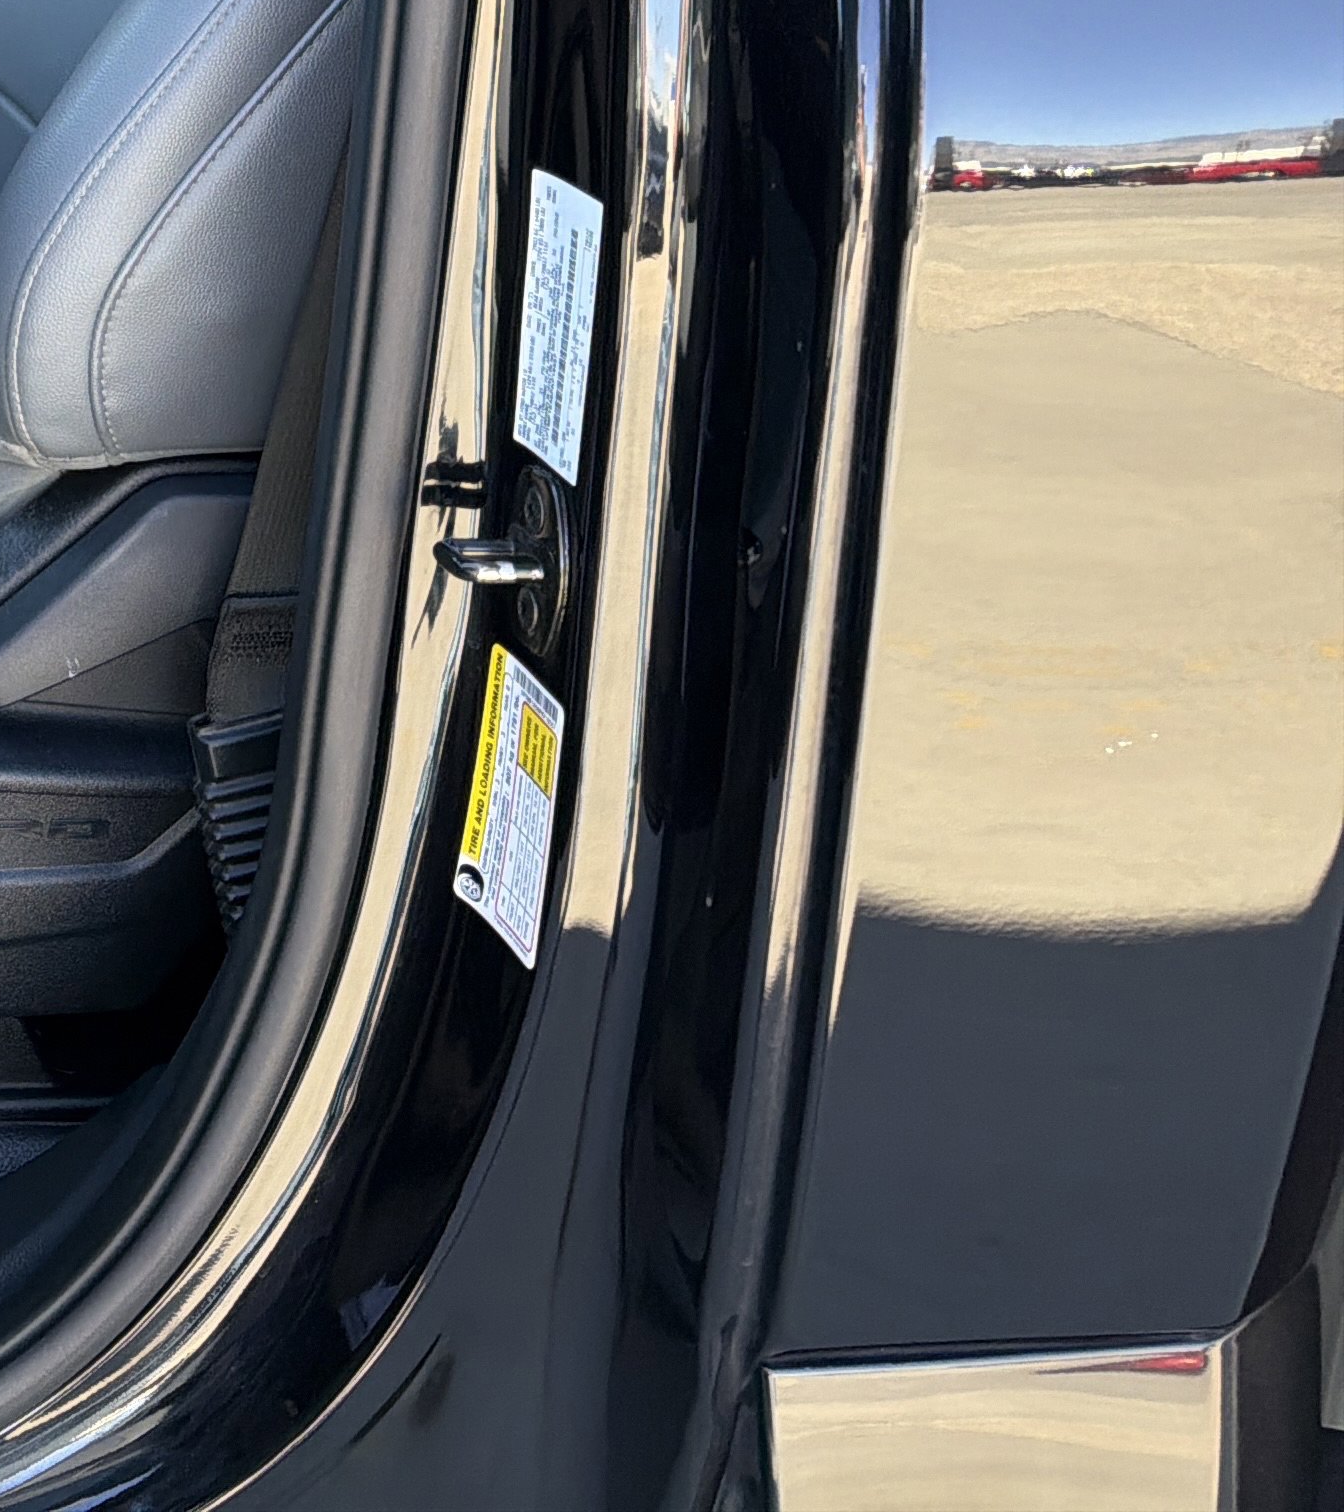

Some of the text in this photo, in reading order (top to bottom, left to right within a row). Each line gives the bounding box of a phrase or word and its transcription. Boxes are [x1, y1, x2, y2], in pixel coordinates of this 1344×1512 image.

[489, 652, 503, 738] INFORMATION
[478, 740, 494, 798] LOADING
[473, 801, 487, 827] AND
[468, 829, 481, 856] TIRE
